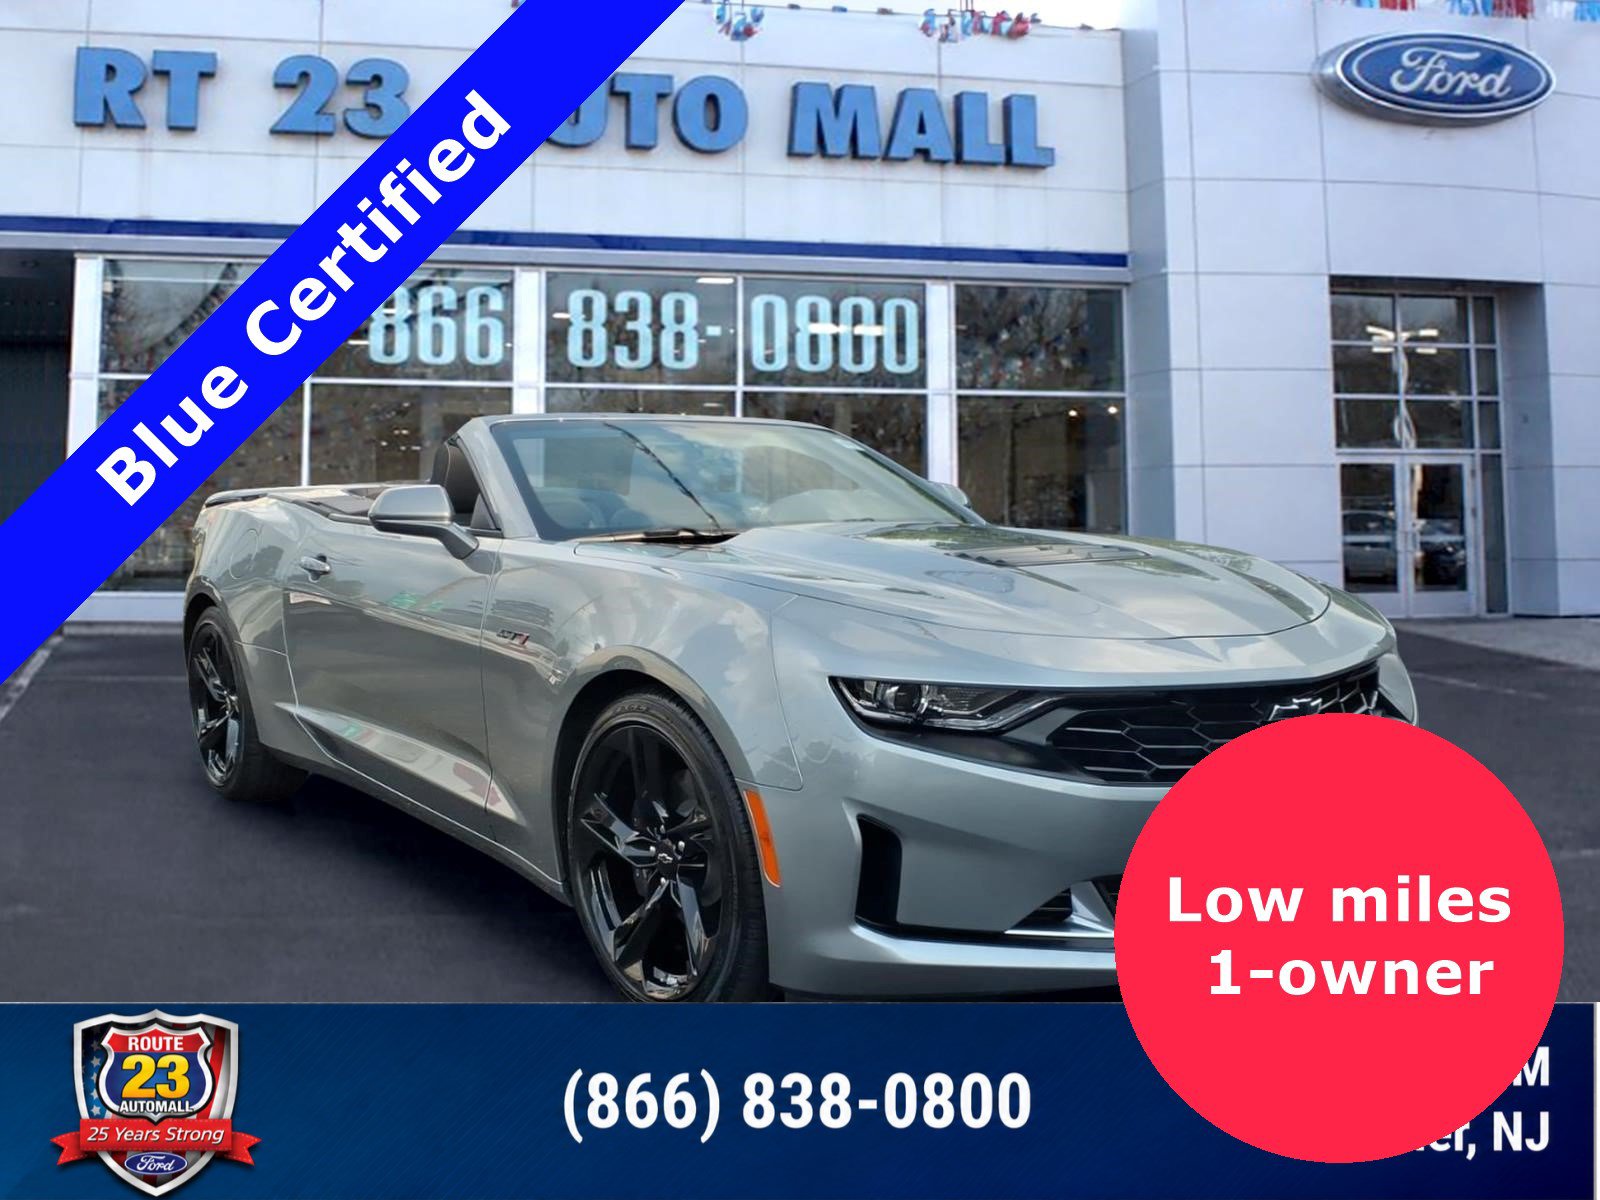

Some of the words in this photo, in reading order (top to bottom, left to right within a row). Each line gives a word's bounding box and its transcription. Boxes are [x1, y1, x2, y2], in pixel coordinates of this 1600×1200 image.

[74, 46, 217, 131] RT
[269, 55, 410, 140] 23
[546, 72, 749, 153] UTO
[787, 81, 1055, 168] MALL
[1390, 46, 1511, 98] Ford
[369, 286, 504, 365] 866
